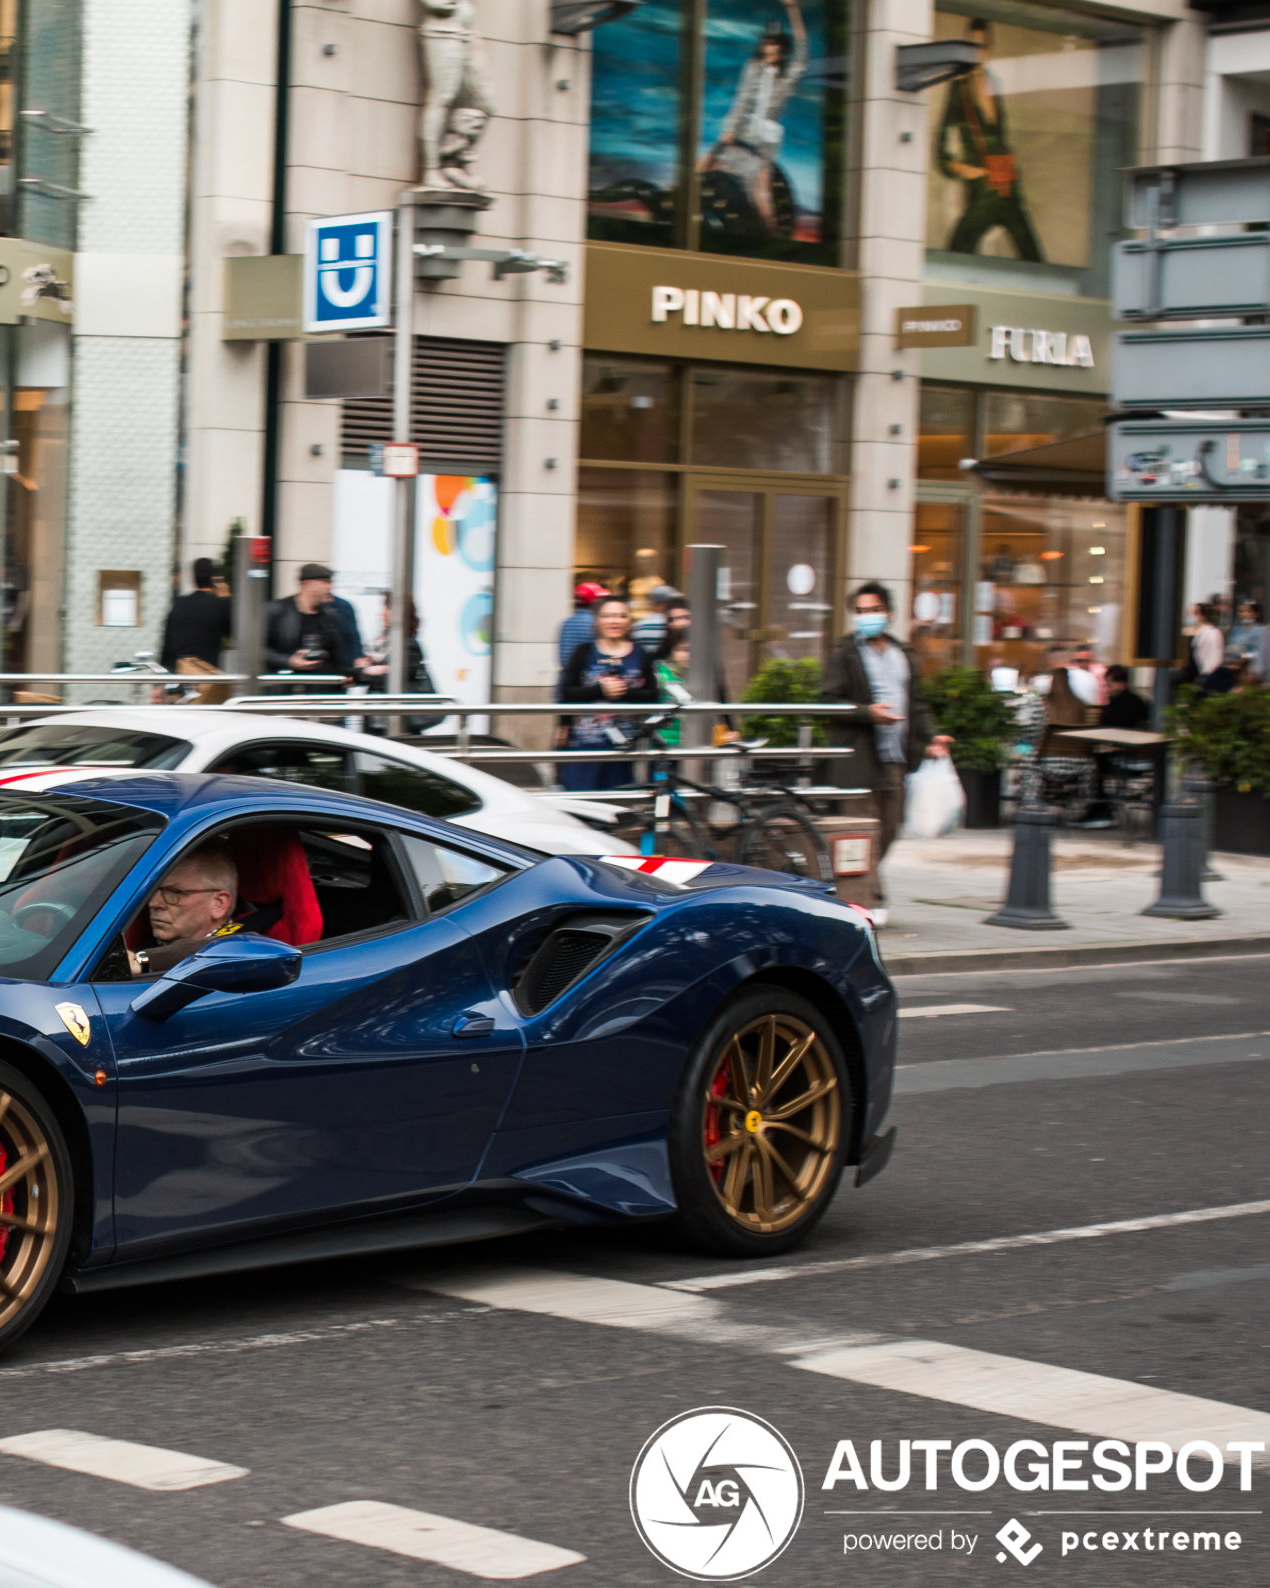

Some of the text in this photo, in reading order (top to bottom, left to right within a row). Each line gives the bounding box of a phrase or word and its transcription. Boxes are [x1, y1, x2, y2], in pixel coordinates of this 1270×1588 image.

[320, 234, 375, 308] U
[651, 285, 804, 335] PINKO
[987, 324, 1096, 368] FURLA
